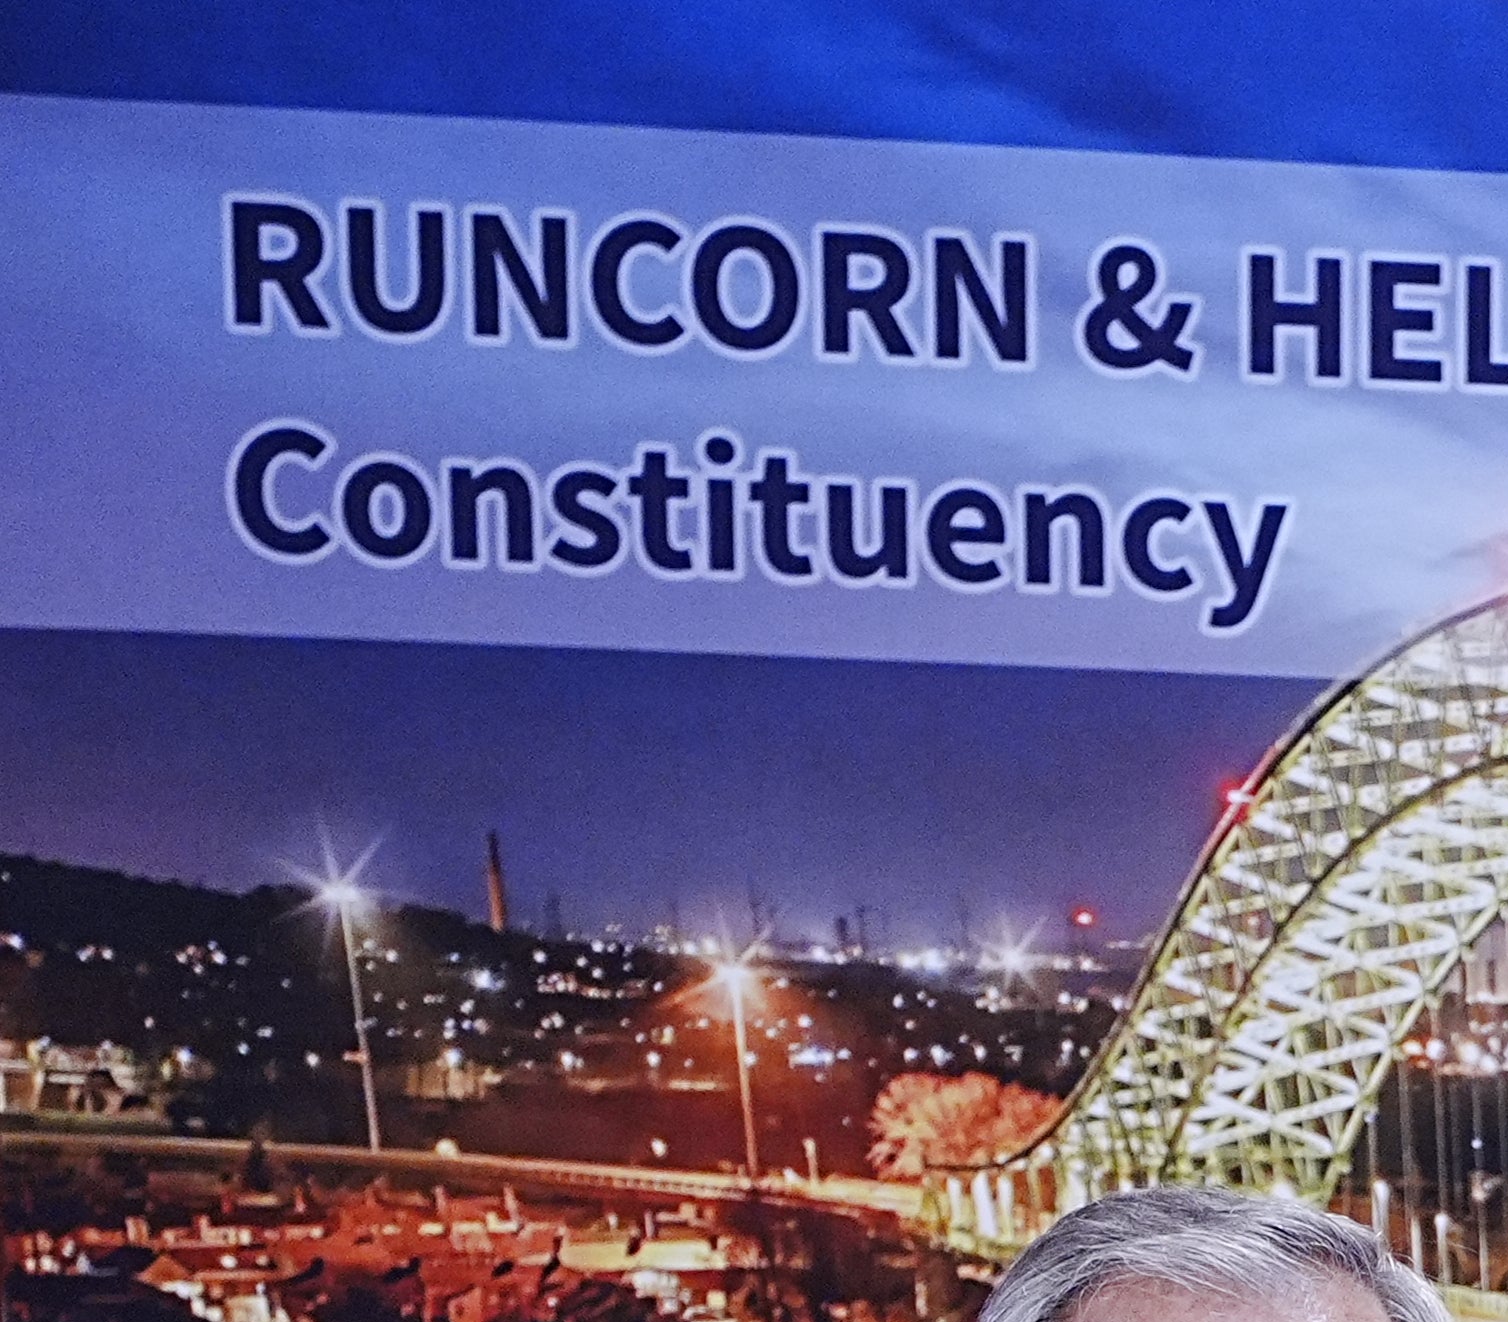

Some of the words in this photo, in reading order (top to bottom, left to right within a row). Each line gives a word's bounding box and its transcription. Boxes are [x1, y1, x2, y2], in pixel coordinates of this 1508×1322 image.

[230, 200, 1029, 364] RUNCORN
[1083, 244, 1195, 372] &
[234, 427, 1288, 628] Constituency
